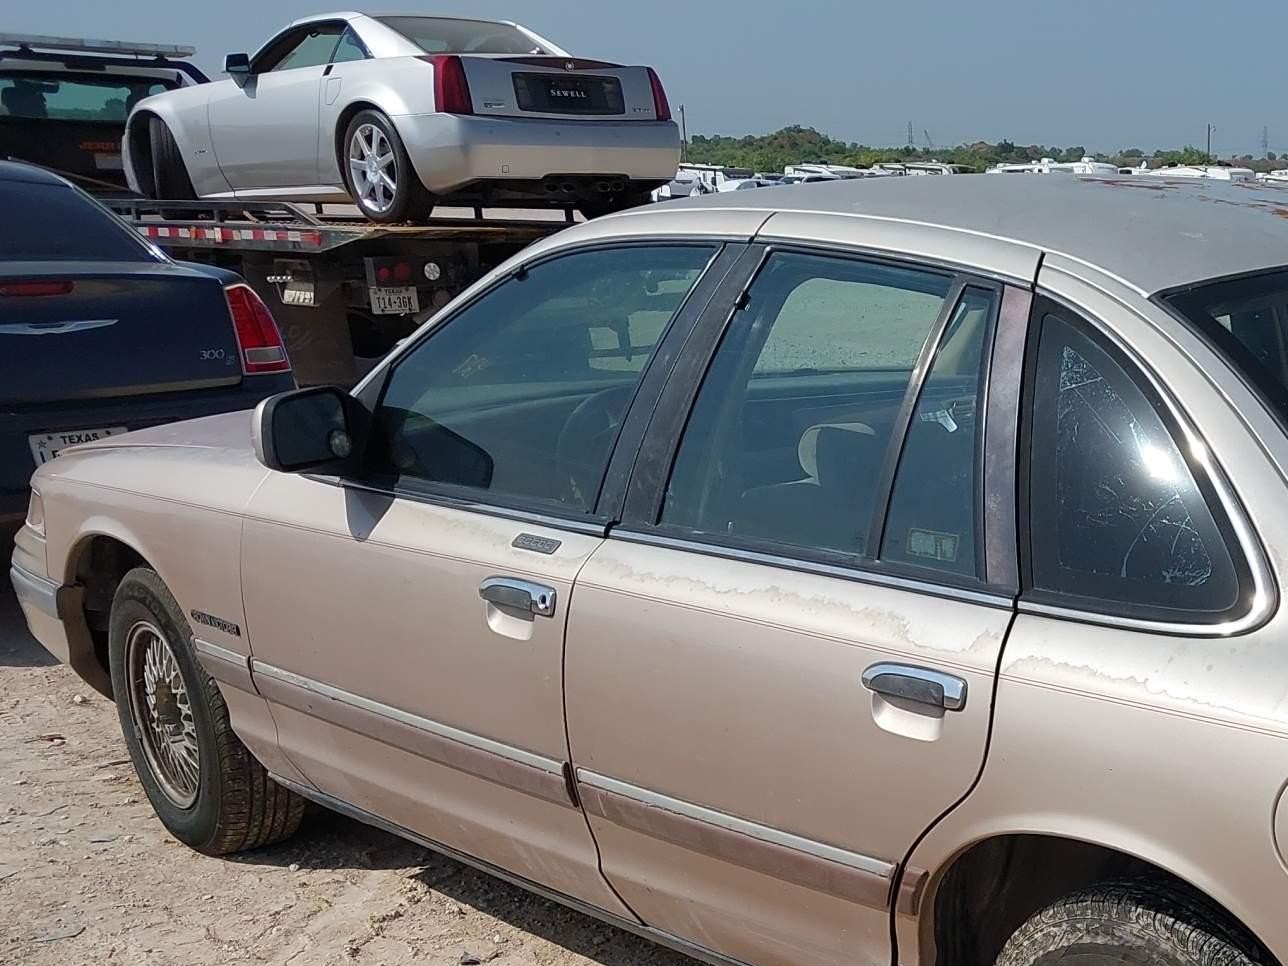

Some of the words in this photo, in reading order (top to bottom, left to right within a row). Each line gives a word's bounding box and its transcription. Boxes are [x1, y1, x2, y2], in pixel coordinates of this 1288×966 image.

[550, 89, 587, 98] SEWELL
[199, 349, 225, 360] 300
[60, 432, 100, 445] TEXAS
